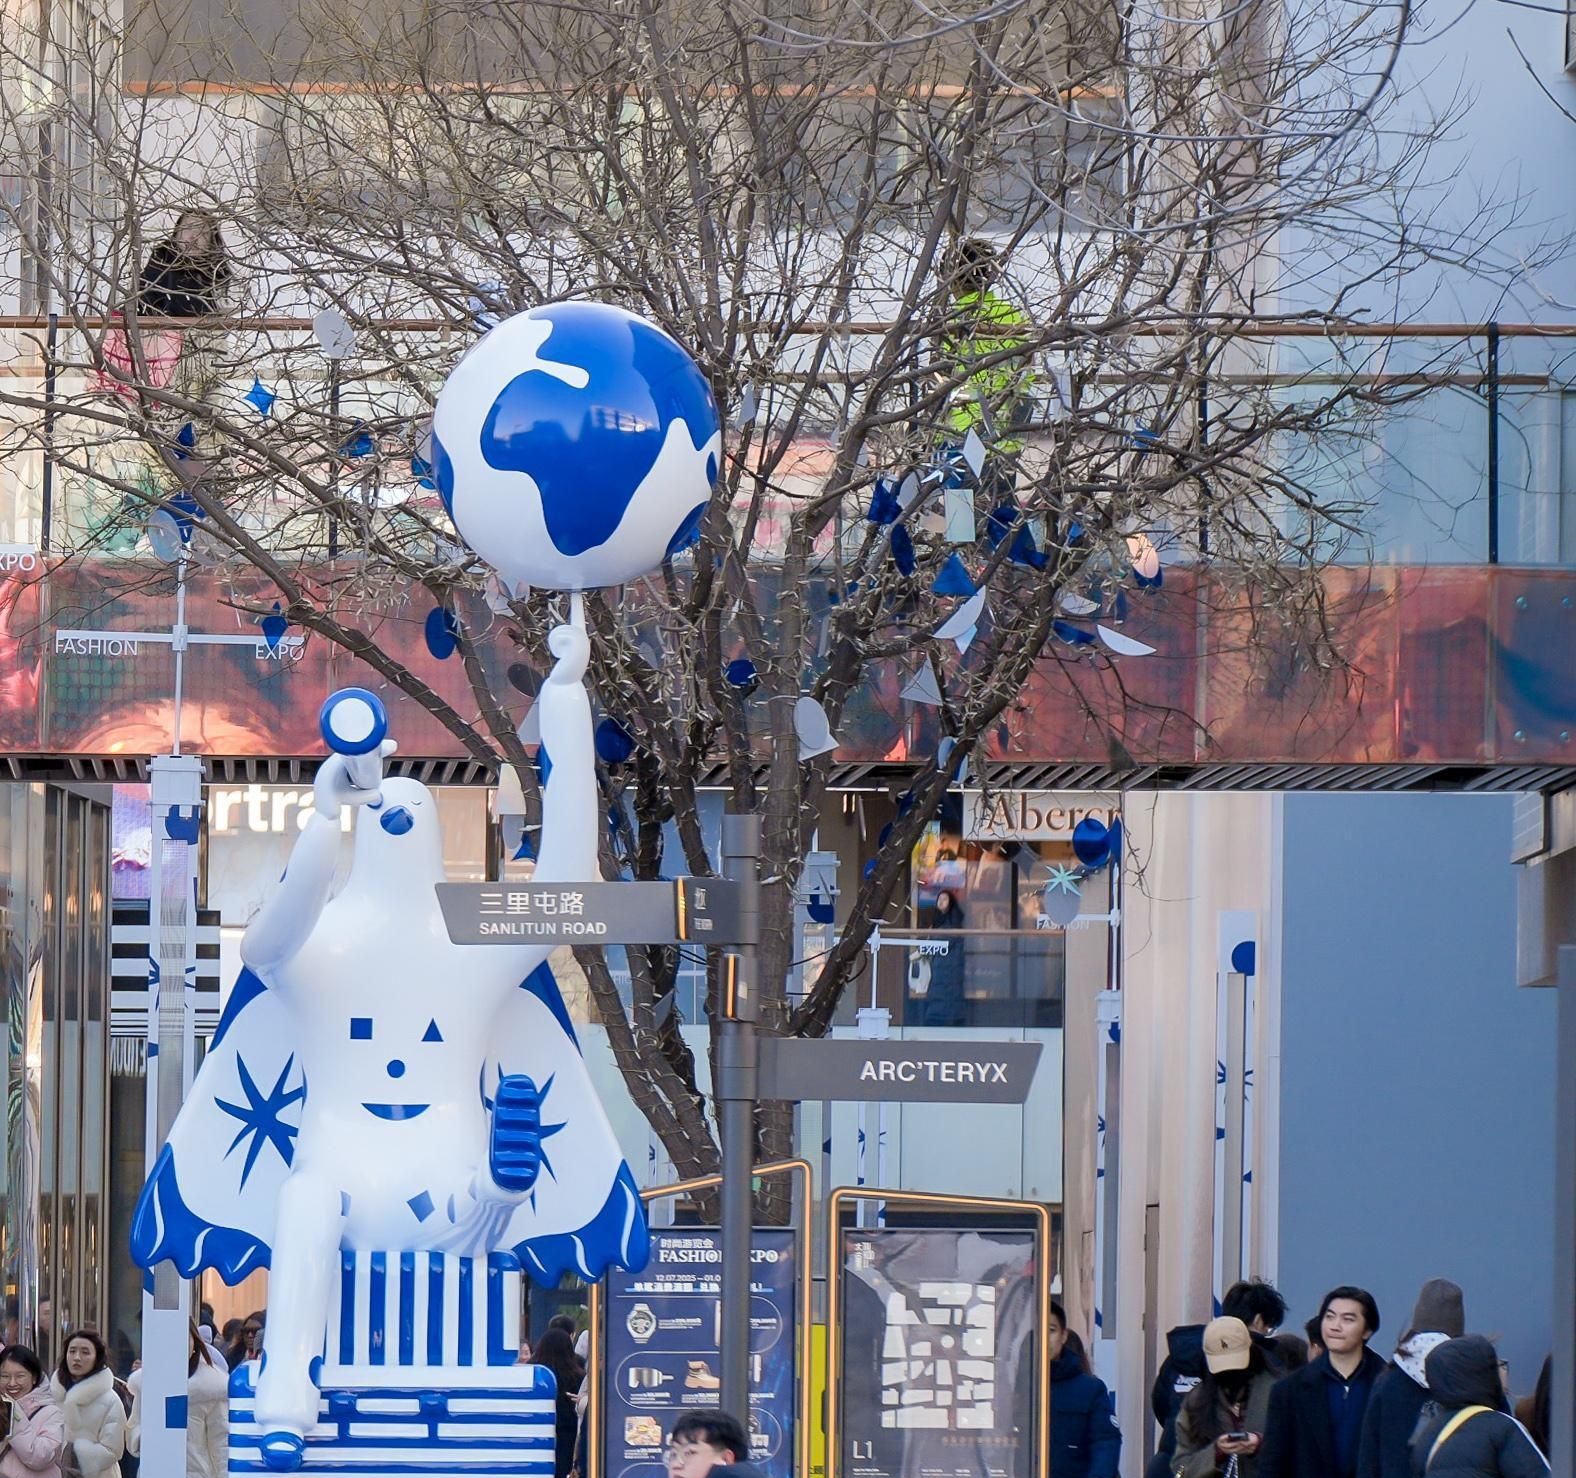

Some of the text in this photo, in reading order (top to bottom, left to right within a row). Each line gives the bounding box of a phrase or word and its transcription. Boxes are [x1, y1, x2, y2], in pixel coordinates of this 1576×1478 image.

[55, 638, 304, 661] FASHION EXPO
[479, 891, 585, 916] 三里屯路
[479, 922, 607, 935] SANLITUN ROAD
[919, 945, 949, 956] EXPO
[852, 1440, 873, 1460] L1
